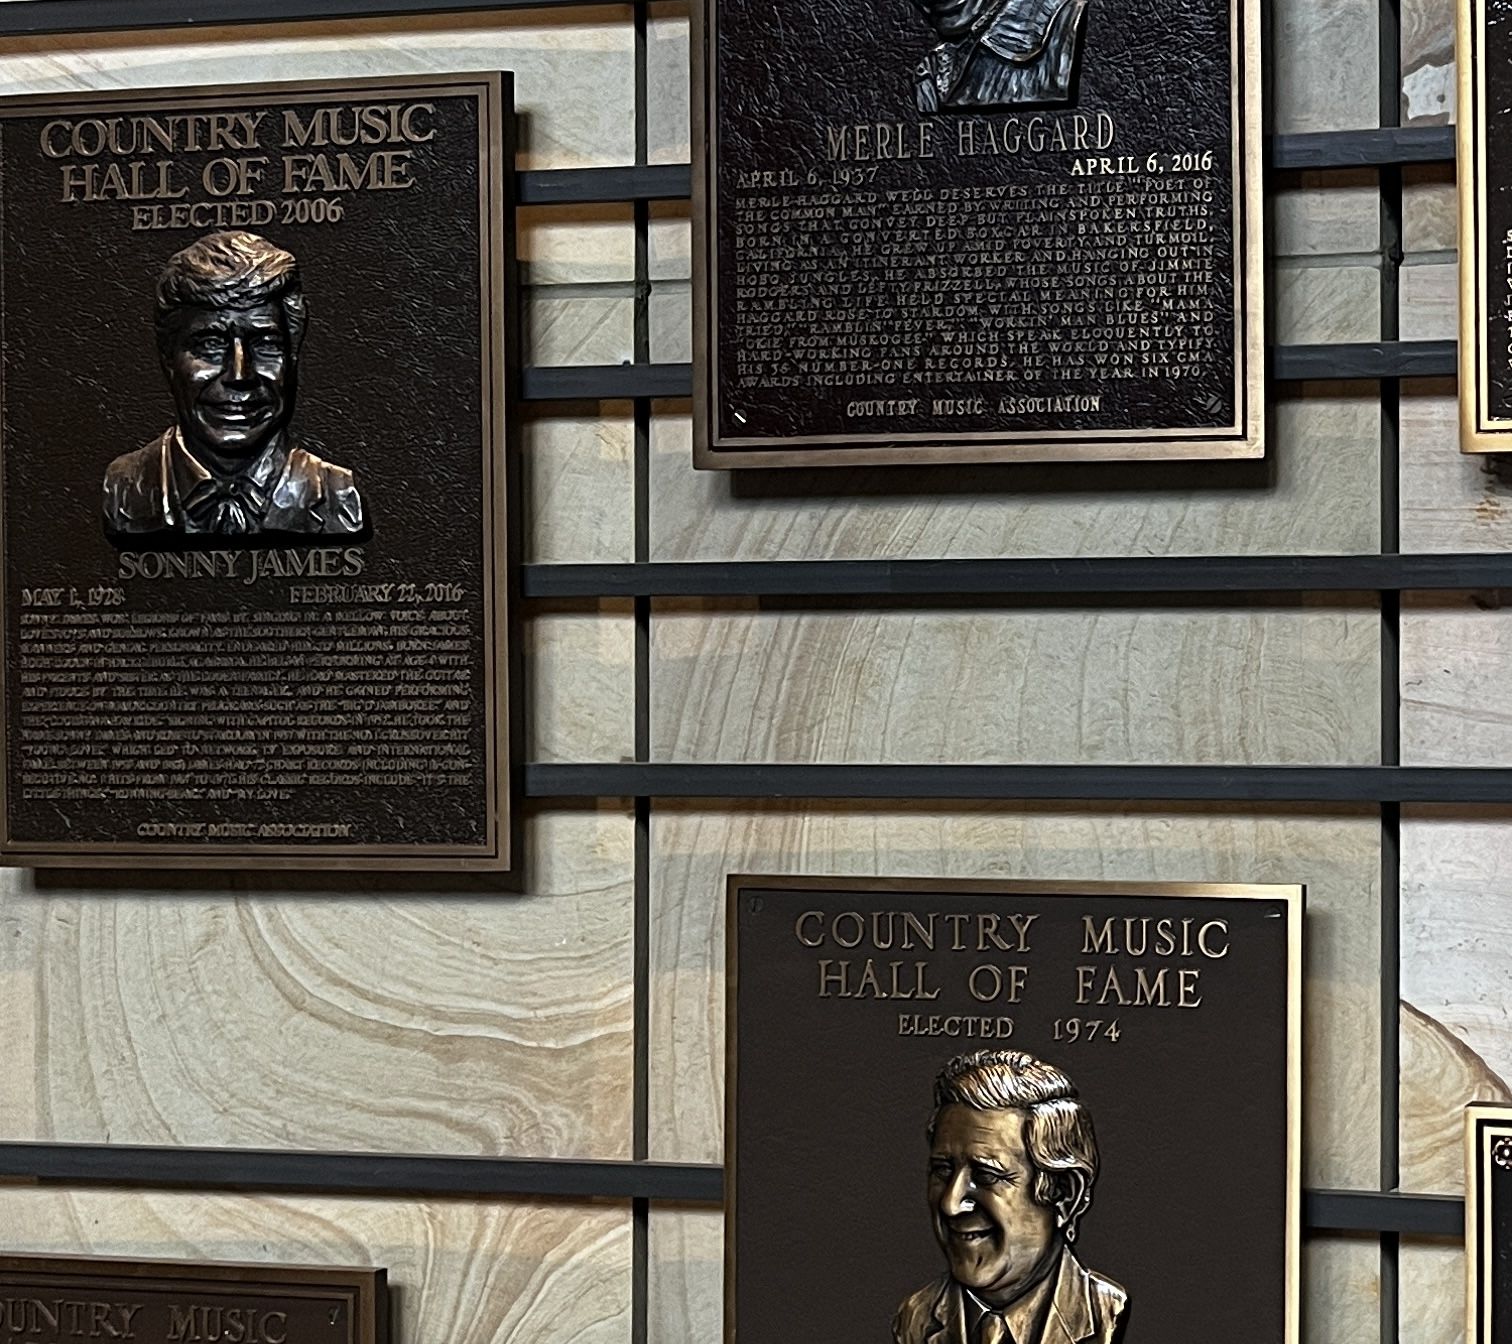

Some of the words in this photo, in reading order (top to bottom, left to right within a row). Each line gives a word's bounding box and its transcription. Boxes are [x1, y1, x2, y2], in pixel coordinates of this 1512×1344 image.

[39, 113, 266, 159] COUNTRY
[281, 103, 437, 148] MUSIC
[826, 122, 934, 162] MERLE
[958, 113, 1115, 156] HAGGARD
[60, 161, 189, 202] HALL
[201, 156, 269, 197] OF
[281, 150, 417, 194] FAME
[1070, 157, 1140, 176] APRIL
[1146, 152, 1164, 174] 6,
[1171, 150, 1213, 173] 2016
[132, 202, 275, 230] ELECTED
[280, 197, 344, 226] 2006
[846, 398, 918, 418] COUNTRY
[932, 396, 985, 416] MUSIC
[998, 394, 1102, 414] ASSOCIATION
[118, 550, 241, 580] SONNY
[243, 547, 365, 585] JAMES
[794, 910, 1041, 953] COUNTRY
[1081, 914, 1231, 960] MUSIC
[817, 959, 941, 1001] HALL
[968, 964, 1030, 1004] OF
[1075, 965, 1204, 1009] FAME
[897, 1014, 1015, 1040] ELECTED
[1051, 1017, 1122, 1044] 1974
